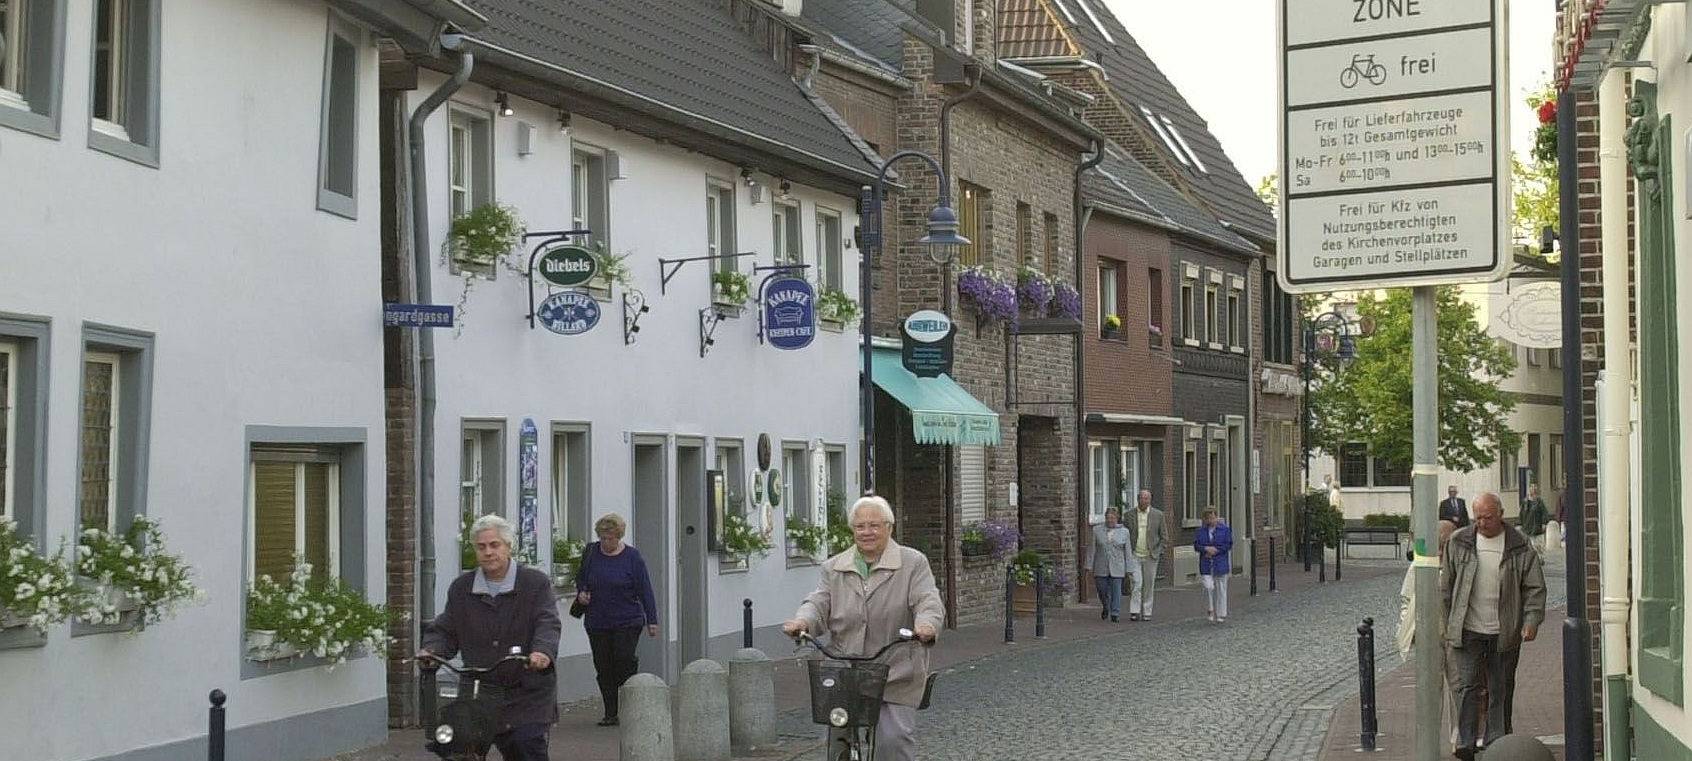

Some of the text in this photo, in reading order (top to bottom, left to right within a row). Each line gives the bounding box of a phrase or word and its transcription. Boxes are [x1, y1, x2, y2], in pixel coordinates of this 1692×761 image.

[1353, 0, 1421, 23] ZONE
[1400, 52, 1436, 76] frei
[1314, 108, 1463, 132] Frei für Lieferfahrzeuge
[1320, 124, 1458, 149] bis 12t Gesamtgewicht
[1295, 155, 1333, 170] Mo-Fr
[1396, 147, 1419, 161] und
[1296, 174, 1312, 188] Sa
[1339, 199, 1439, 217] Frei für Kfz von
[1323, 214, 1457, 235] Nutzungsberechtigten
[1321, 232, 1458, 252] des Kirchenvorplatzes
[1312, 247, 1468, 270] Garagen und Stellplätzen
